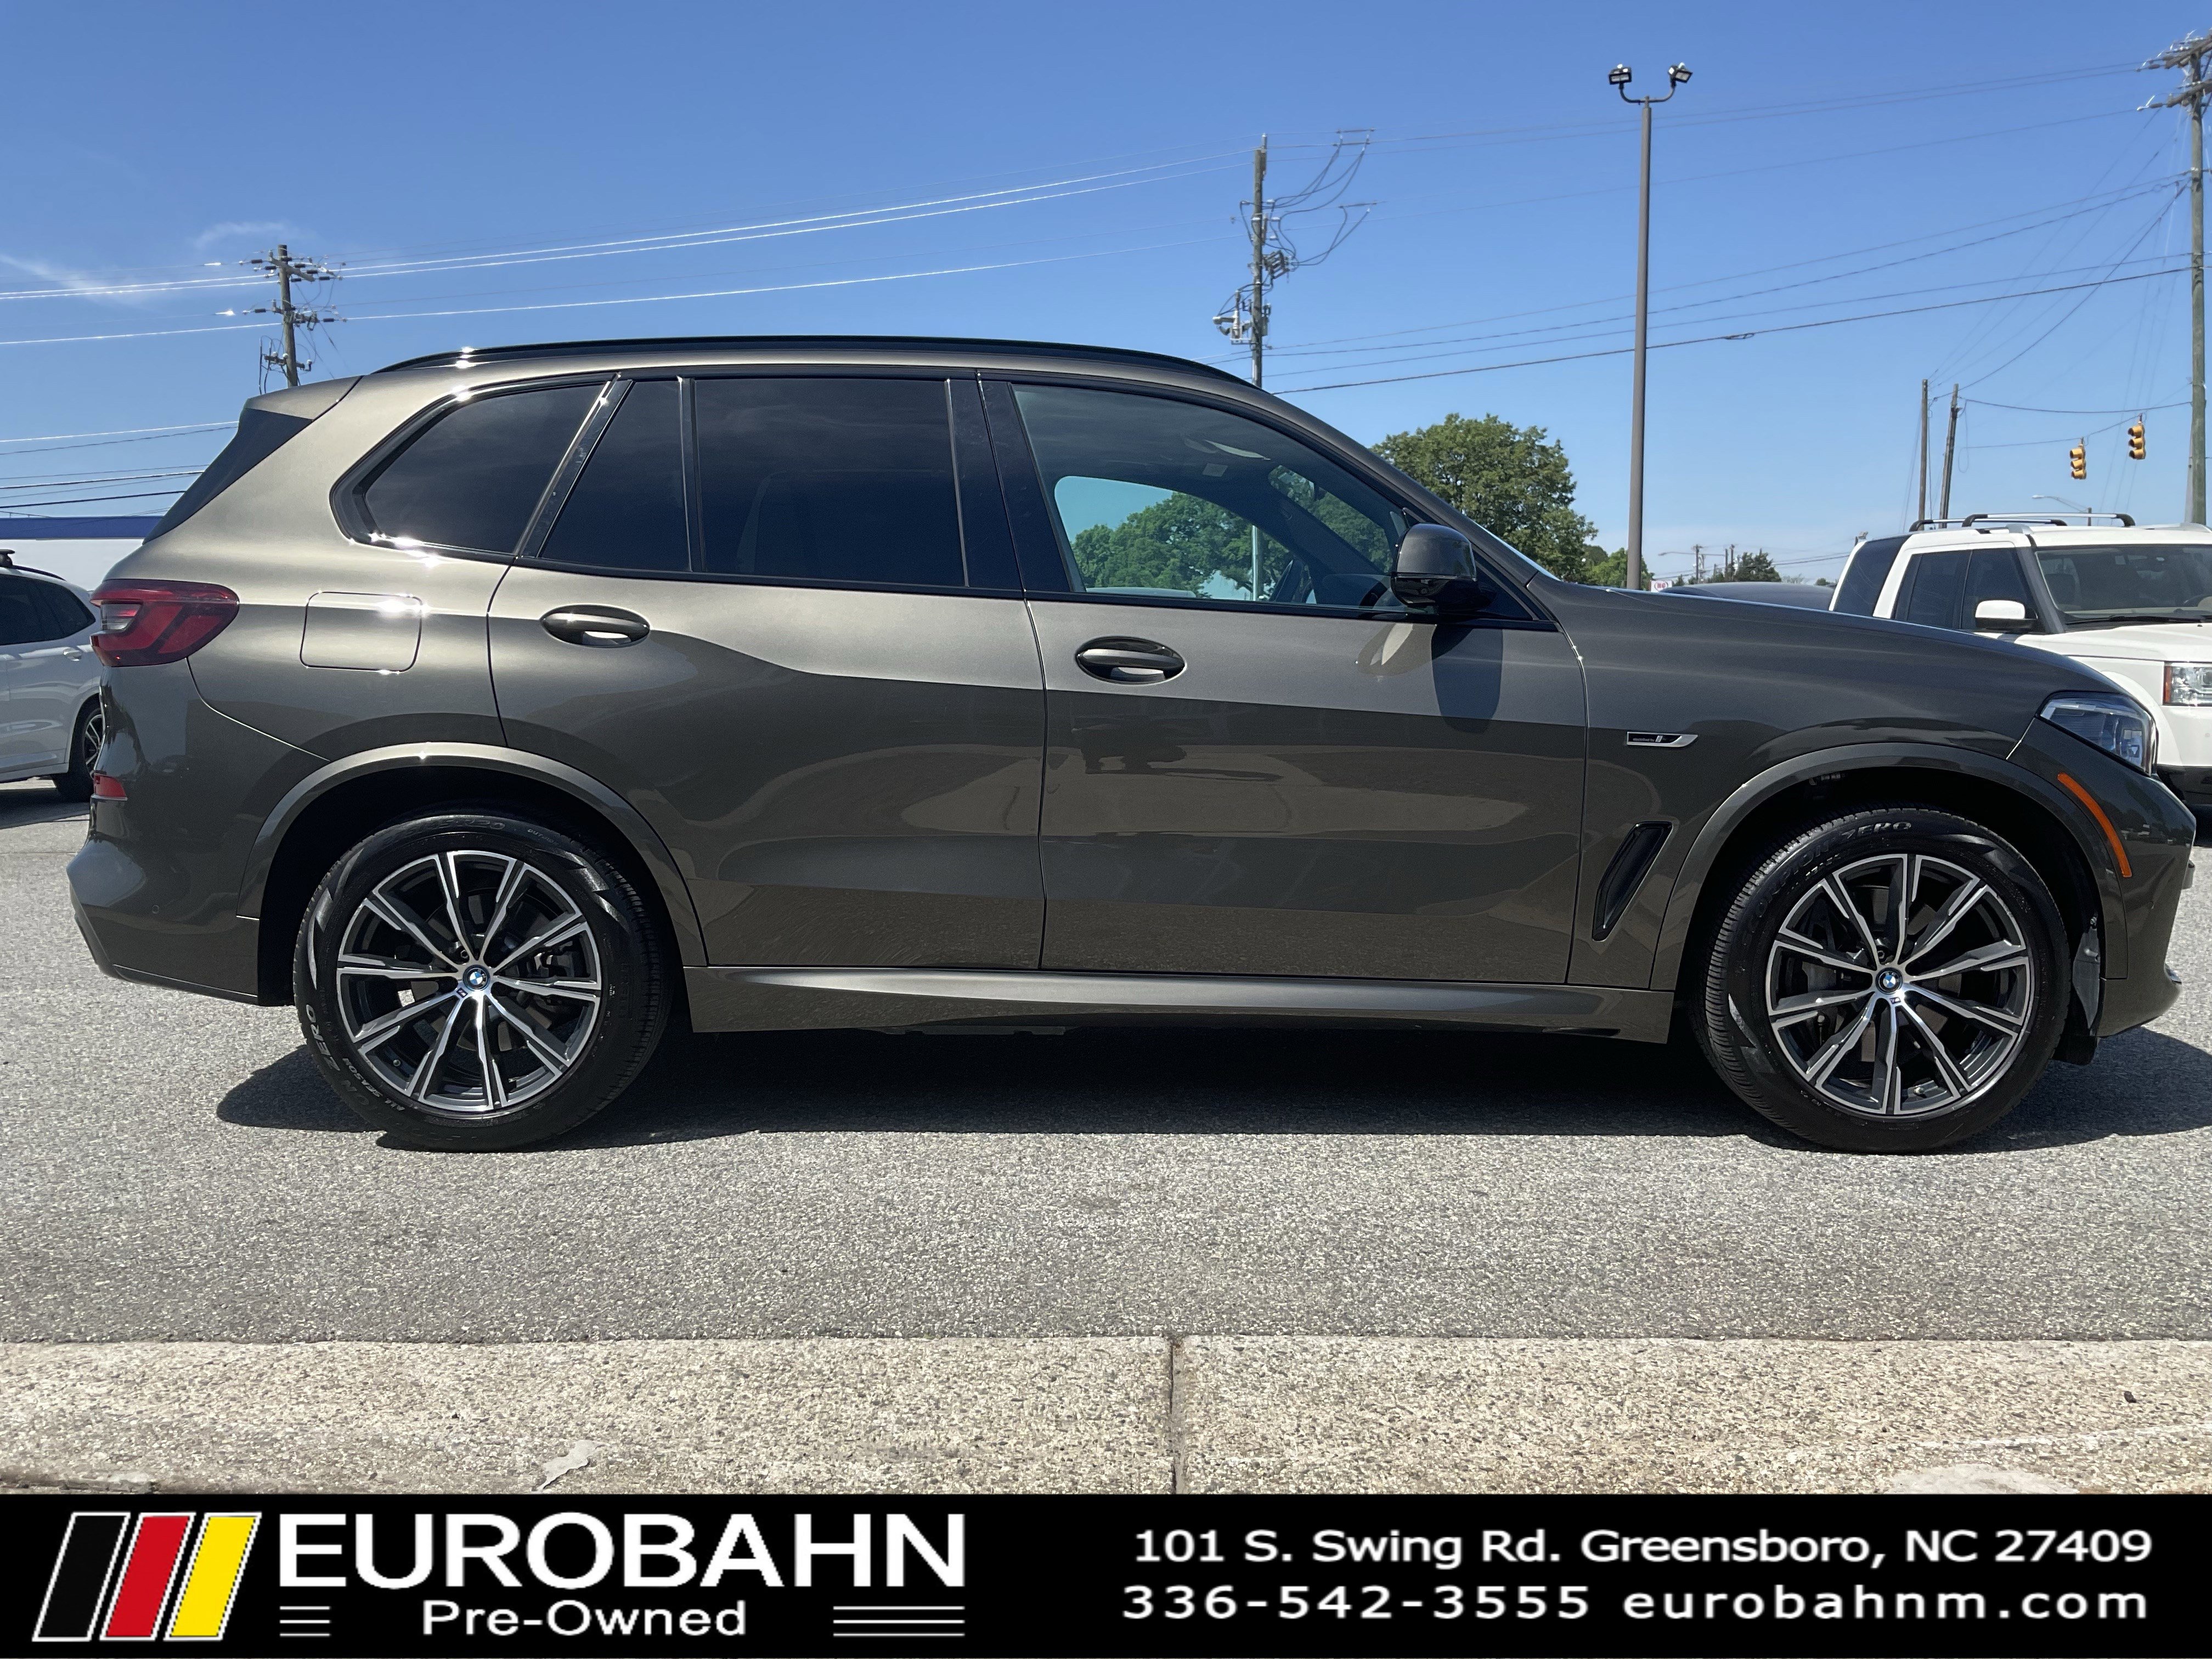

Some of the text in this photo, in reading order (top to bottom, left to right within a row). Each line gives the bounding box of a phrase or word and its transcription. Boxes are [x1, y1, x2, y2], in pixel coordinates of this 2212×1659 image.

[1841, 821, 1912, 840] ZERO
[305, 1004, 341, 1071] ZERO
[342, 1057, 405, 1111] ALL SEASON
